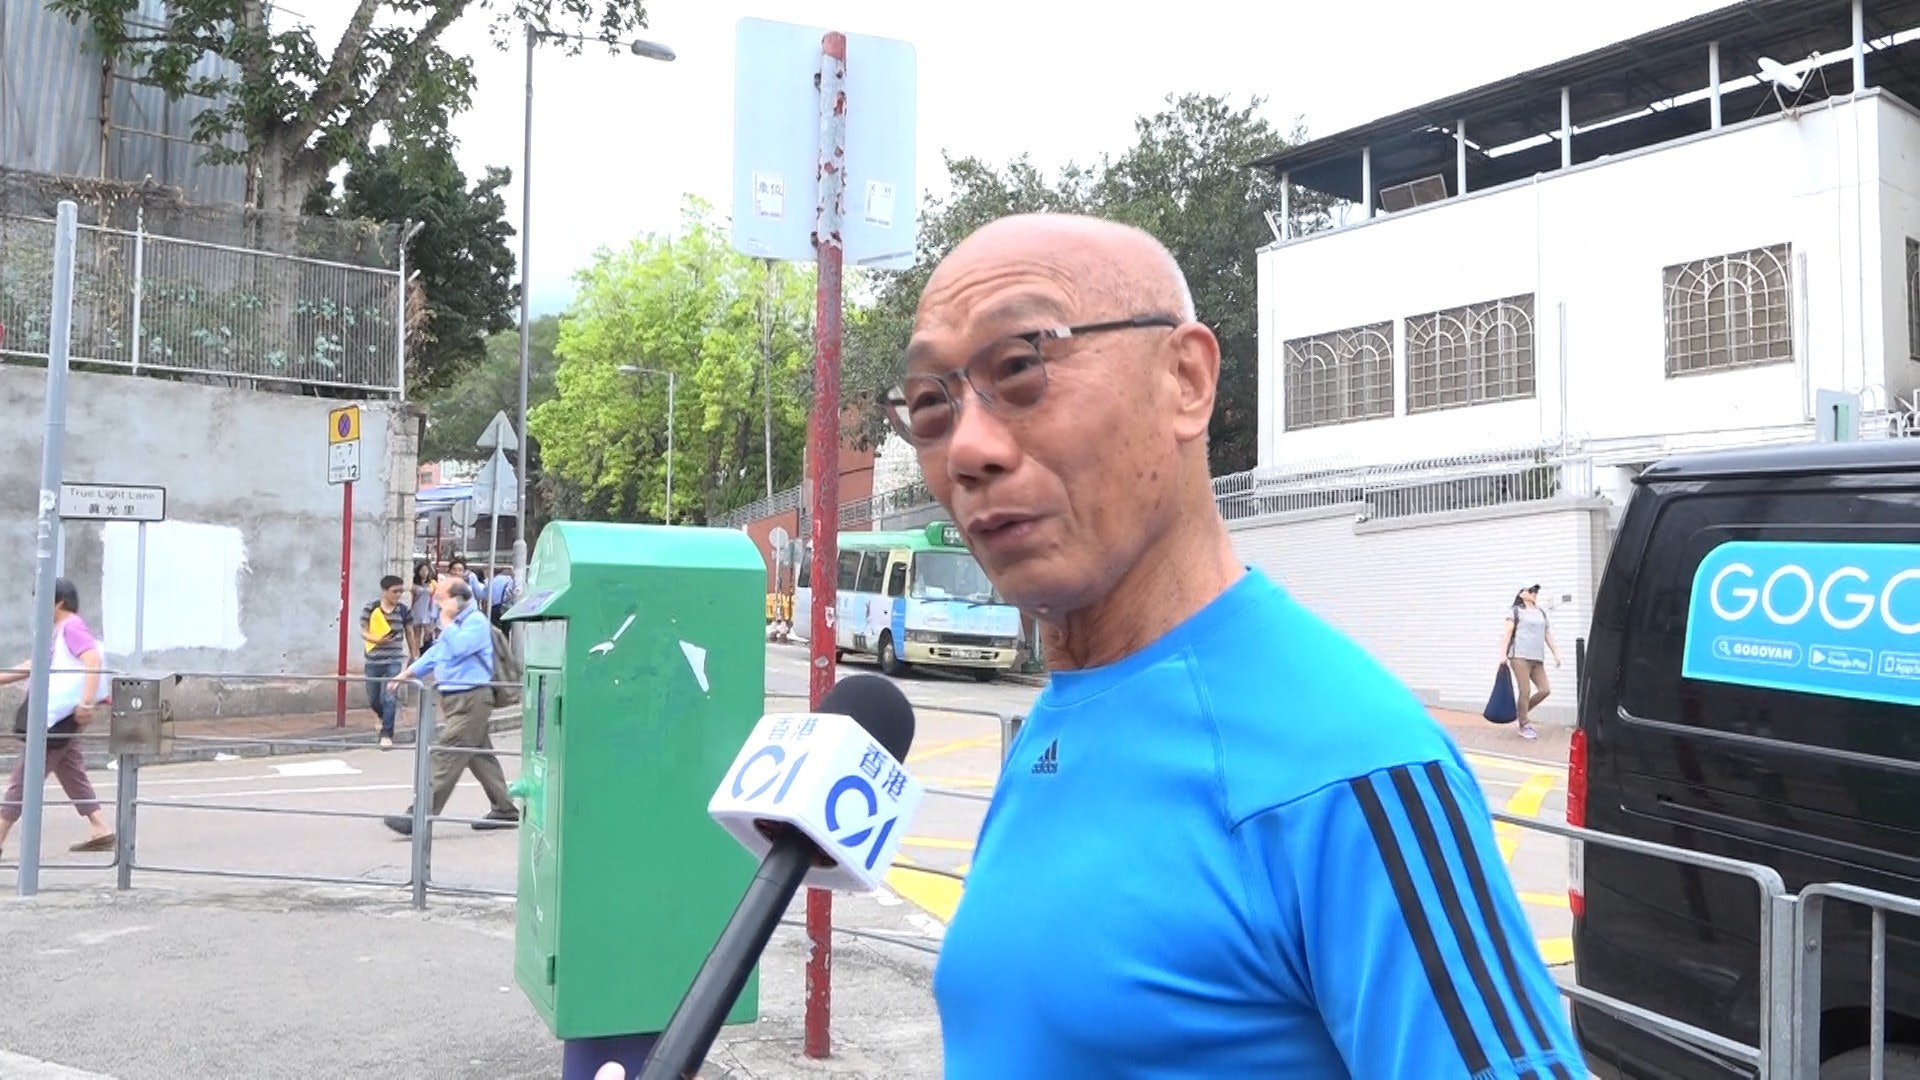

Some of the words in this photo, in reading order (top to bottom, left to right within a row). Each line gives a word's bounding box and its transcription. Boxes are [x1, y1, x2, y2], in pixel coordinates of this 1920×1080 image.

[348, 443, 354, 456] 7
[347, 464, 357, 478] 12
[69, 487, 95, 498] True
[98, 489, 125, 501] Light
[128, 491, 156, 500] Lane
[1733, 643, 1793, 660] GOGOVAN
[768, 717, 819, 741] 香港
[859, 742, 909, 803] 香港
[1031, 761, 1058, 774] adidas
